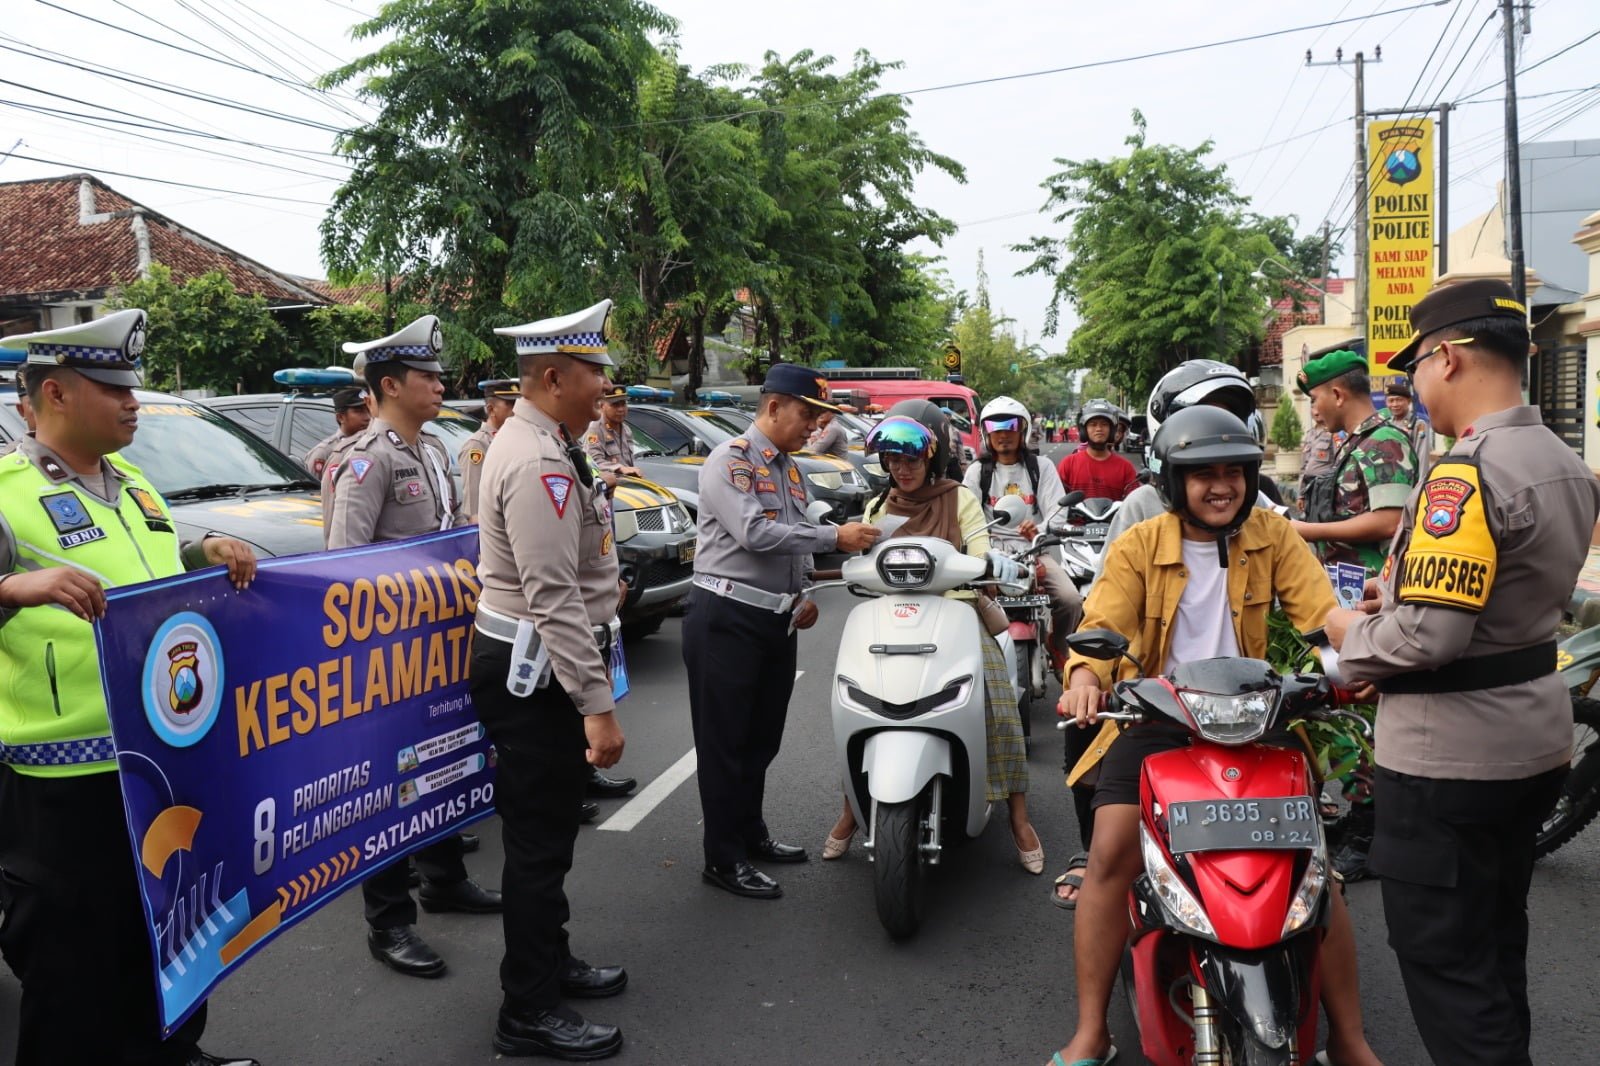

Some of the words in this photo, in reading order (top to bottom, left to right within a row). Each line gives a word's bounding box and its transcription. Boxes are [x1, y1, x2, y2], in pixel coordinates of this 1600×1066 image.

[1375, 194, 1428, 213] POLISI
[1373, 221, 1429, 240] POLICE
[1374, 251, 1401, 263] KAMI
[1404, 250, 1428, 262] SIAP
[1376, 266, 1426, 279] MELAYANI
[1387, 283, 1414, 295] ANDA
[1372, 323, 1413, 340] PAMEKA
[65, 528, 100, 545] IBNU
[428, 698, 463, 718] Terhitung
[293, 760, 371, 817] PRIORITAS
[282, 783, 393, 859] PELANGGARAN
[1173, 806, 1189, 826] M
[1205, 802, 1260, 822] 3635
[1283, 801, 1311, 821] GR
[253, 797, 276, 876] 8
[364, 795, 466, 861] SATLANTAS
